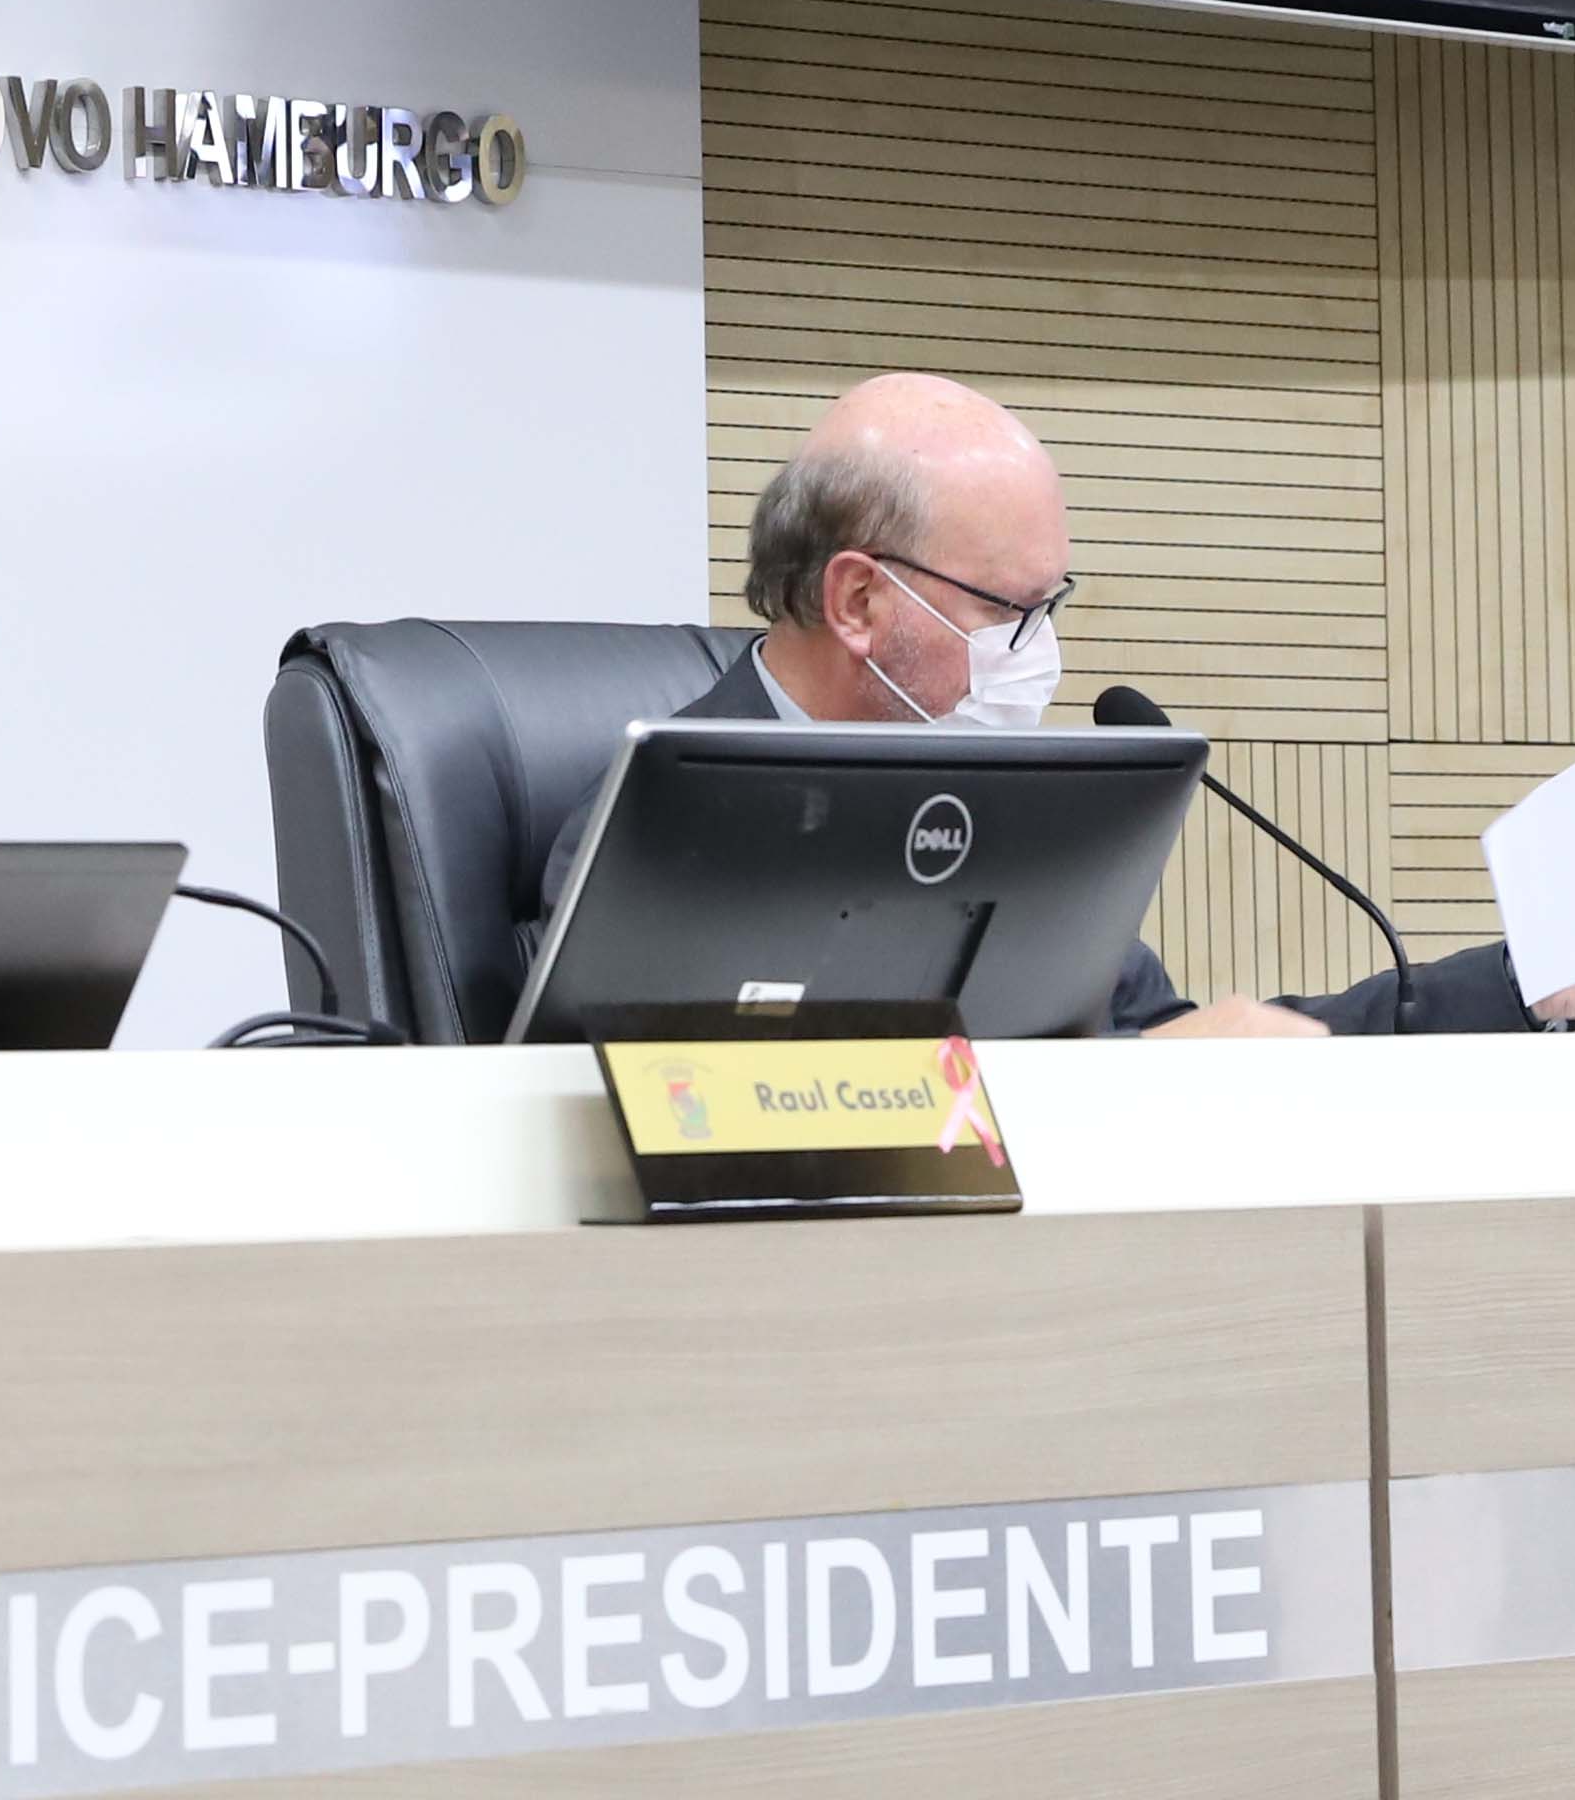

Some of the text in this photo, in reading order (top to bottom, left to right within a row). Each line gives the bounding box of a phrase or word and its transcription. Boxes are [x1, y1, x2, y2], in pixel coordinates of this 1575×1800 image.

[122, 84, 528, 205] HAMBURGO
[915, 827, 963, 852] DELL
[753, 1076, 936, 1114] Raul Cassel
